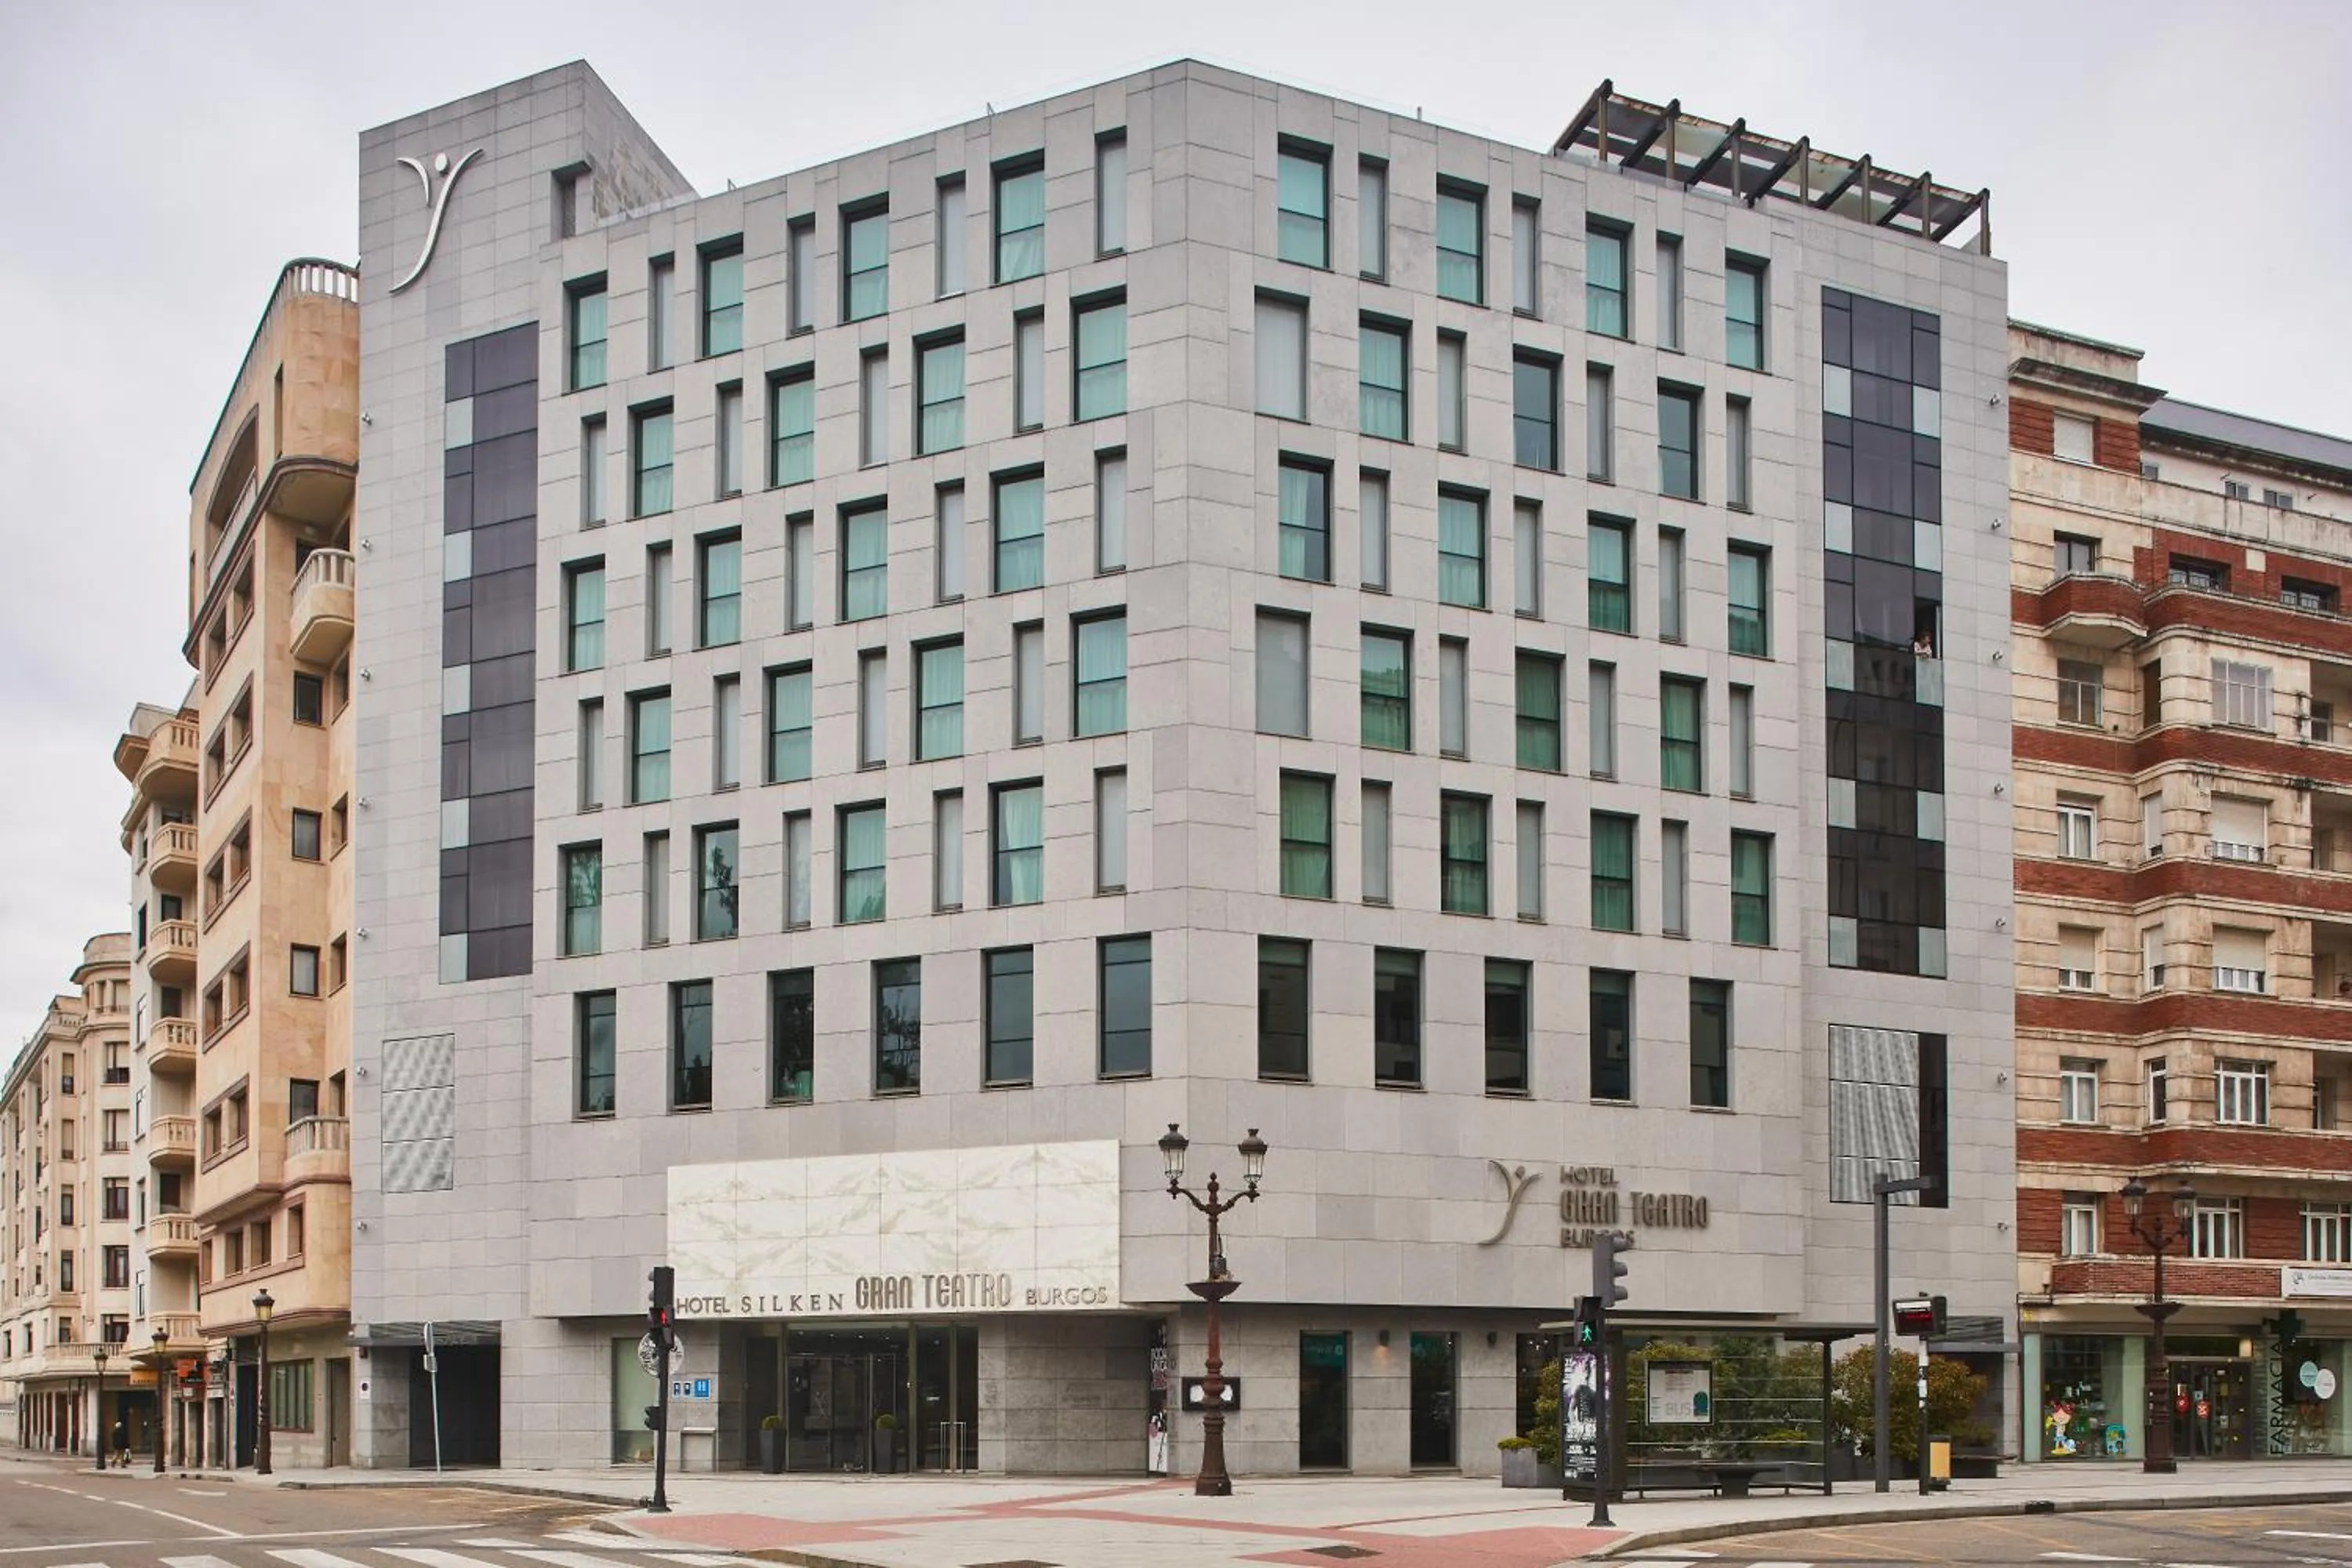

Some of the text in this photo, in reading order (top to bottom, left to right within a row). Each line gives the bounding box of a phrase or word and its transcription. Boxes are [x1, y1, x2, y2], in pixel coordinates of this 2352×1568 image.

[1560, 1165, 1619, 1187] HOTEL
[1560, 1189, 1709, 1229] GRAN TEATRO
[1560, 1227, 1635, 1249] BURS
[677, 1272, 1109, 1314] HOTEL SILKEN GRAN TEATRO BURGOS
[2270, 1341, 2284, 1455] FARMACIA
